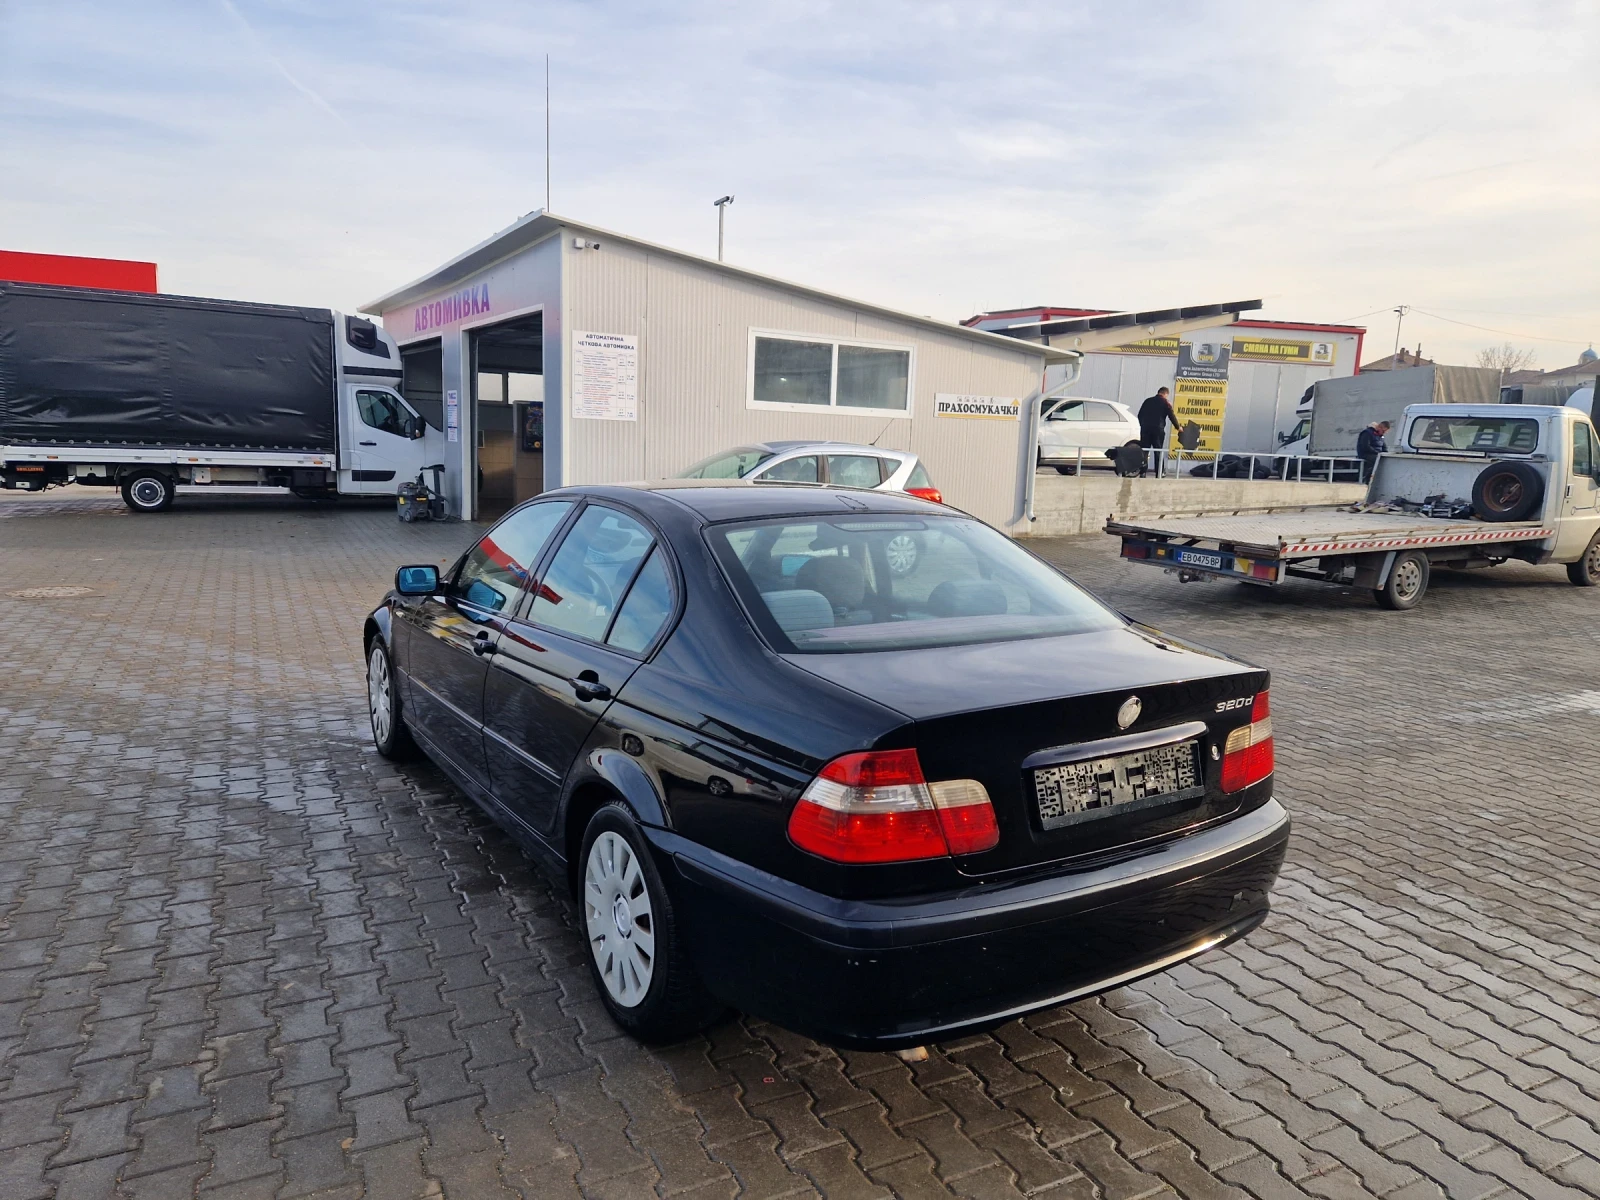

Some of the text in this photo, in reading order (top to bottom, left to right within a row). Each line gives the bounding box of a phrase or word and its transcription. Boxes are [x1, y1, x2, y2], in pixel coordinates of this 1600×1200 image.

[415, 283, 490, 332] АВТОМИВКА
[1155, 339, 1178, 348] ФИЛТРИ
[1243, 343, 1299, 355] СМЯНА НА ГУМИ
[1179, 384, 1223, 394] ДИАГНОСТИКА
[1187, 399, 1212, 407] РЕМОНТ
[938, 402, 1019, 415] ПРАХОСМУКАЧКИ
[1177, 407, 1220, 416] ХОДОВА ЧАСТ
[1192, 555, 1210, 565] 0475
[1215, 696, 1254, 713] 320d
